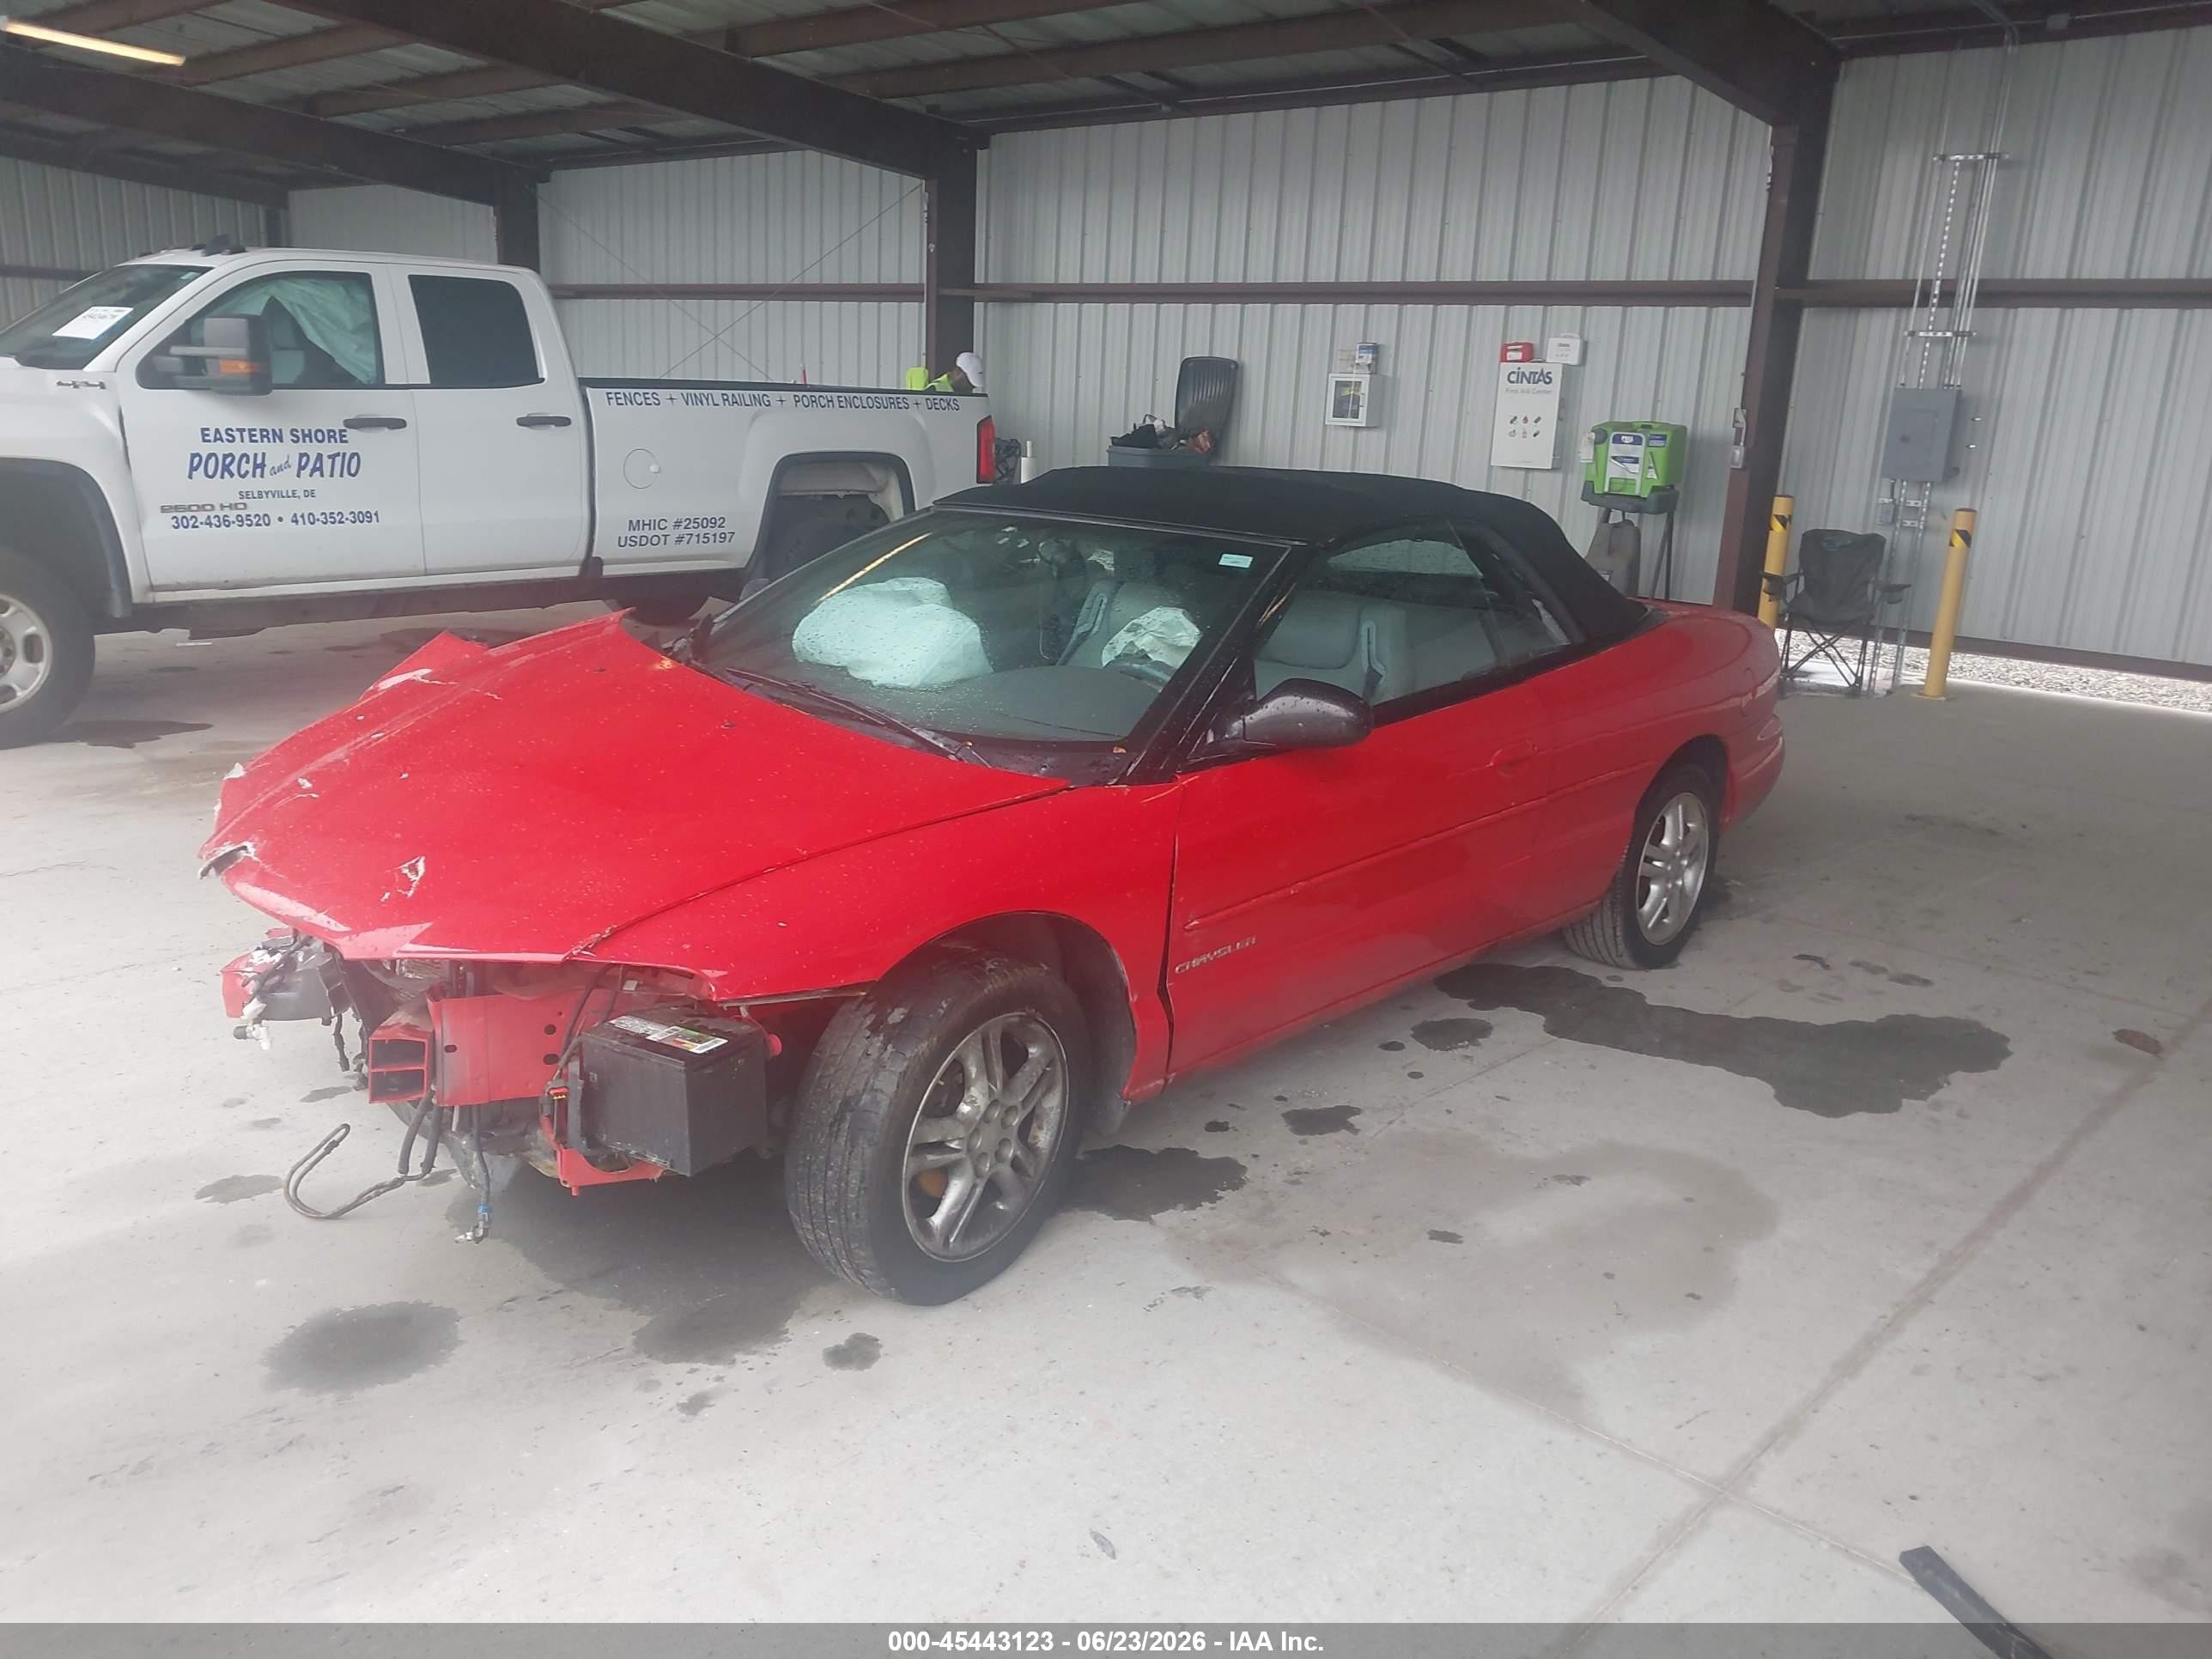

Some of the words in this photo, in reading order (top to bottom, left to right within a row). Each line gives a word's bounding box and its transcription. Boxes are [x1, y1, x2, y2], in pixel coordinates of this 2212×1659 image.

[1507, 367, 1553, 385] CINTAS
[605, 392, 660, 406] FENCES
[681, 392, 719, 406] VINYL
[722, 392, 771, 408] RAILING
[793, 394, 835, 409] PORCH
[837, 395, 910, 410] ENCLOSURES
[926, 398, 960, 411] DECKS
[200, 428, 284, 444] EASTERN
[290, 428, 349, 444] SHORE
[187, 452, 267, 480] PORCH
[270, 454, 292, 477] and
[295, 452, 362, 478] PATIO
[238, 489, 301, 501] SELBYVILLE,
[303, 489, 317, 499] DE
[160, 503, 216, 514] 2500
[220, 501, 248, 511] HD
[171, 513, 271, 530] 302-436-9520
[290, 510, 380, 526] 410-352-3091
[628, 519, 668, 532] MHIC
[672, 516, 726, 530] #25092
[617, 534, 671, 548] USDOT
[674, 532, 736, 545] #715197
